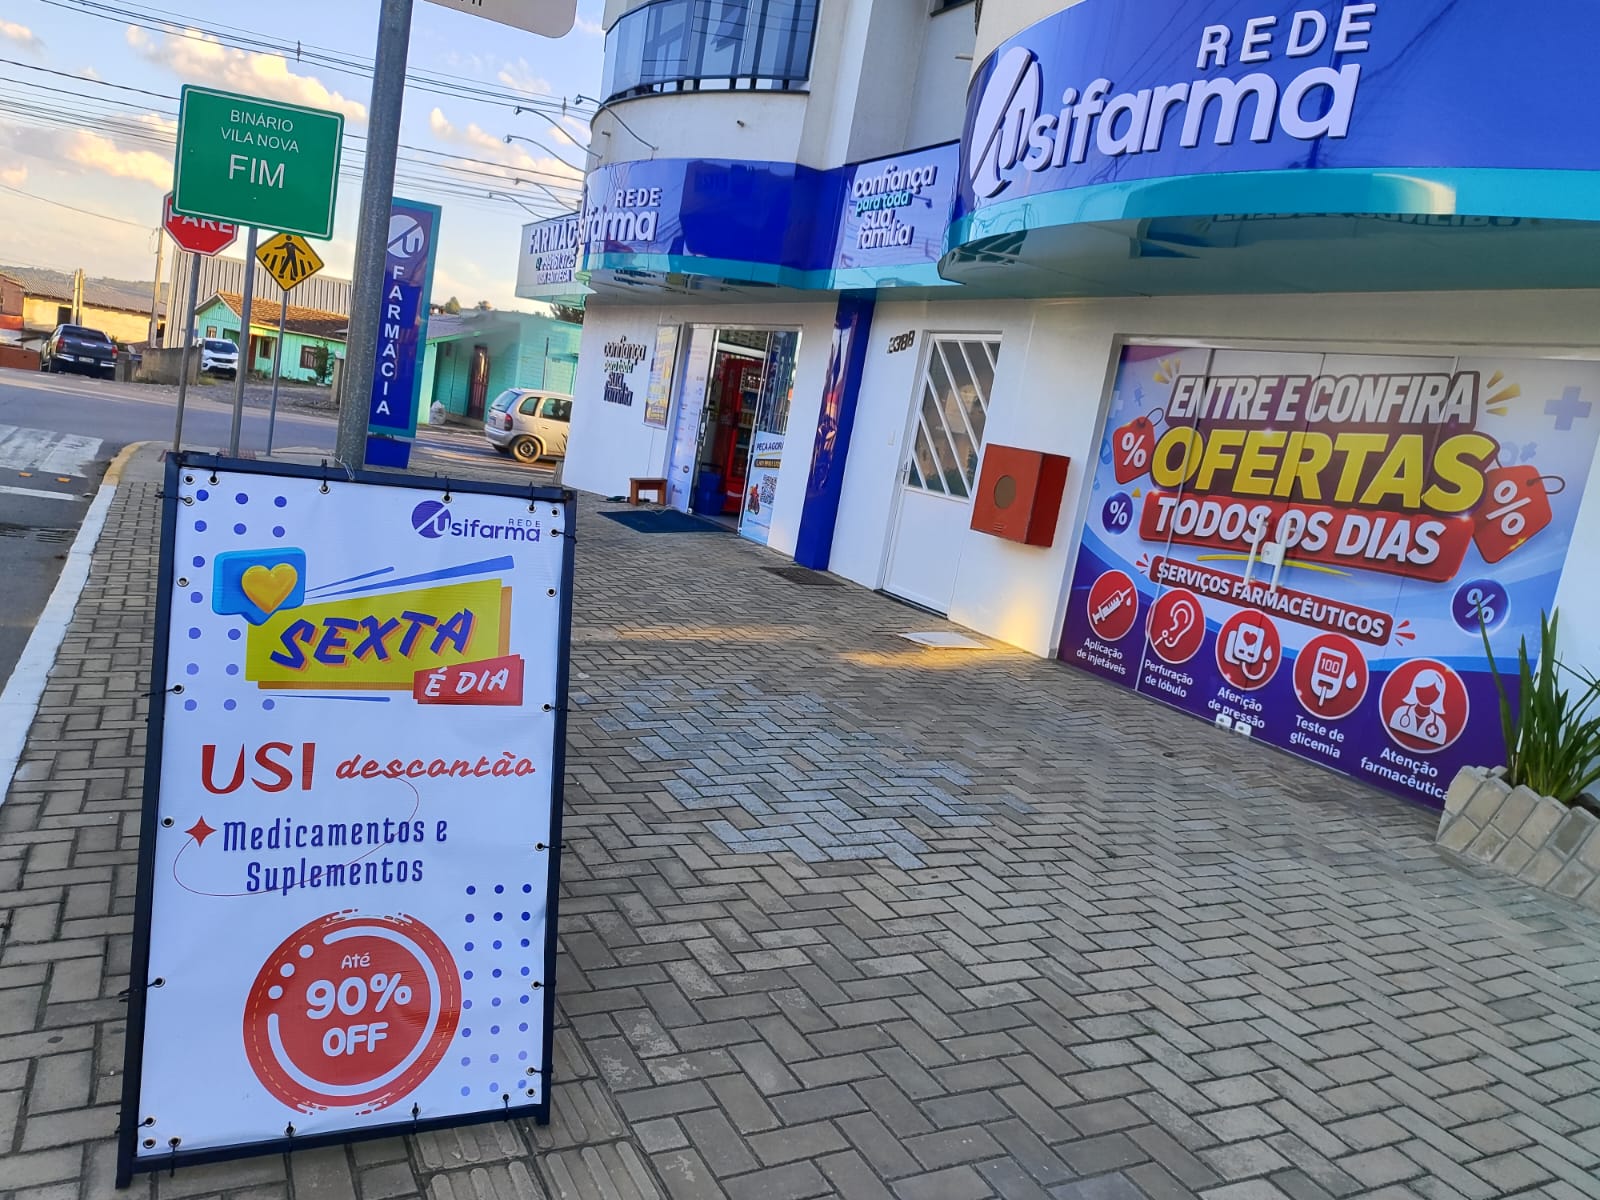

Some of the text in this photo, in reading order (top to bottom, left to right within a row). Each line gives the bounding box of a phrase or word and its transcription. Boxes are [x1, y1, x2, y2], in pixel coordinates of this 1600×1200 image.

[1196, 3, 1377, 69] REDE
[230, 109, 294, 133] BINÁRIO
[221, 127, 299, 153] VILA NOVA
[229, 154, 285, 189] FIM
[855, 164, 938, 198] confiança
[616, 187, 662, 208] REDE
[856, 191, 913, 217] para toda
[864, 209, 896, 231] sua
[376, 265, 405, 415] FARMÁCIA
[1169, 373, 1475, 424] ENTRE E CONFIRA
[1151, 425, 1497, 513] OFERTAS
[508, 518, 541, 528] REDE
[1156, 496, 1447, 565] TODOS OS DIAS
[1157, 562, 1386, 639] SERVIÇOS FARMACÊUTICOS
[269, 607, 478, 672] SEXTA
[1083, 637, 1123, 661] Aplicação
[1076, 649, 1127, 675] de injetáveis
[1144, 659, 1194, 686] Perfuração
[1320, 658, 1340, 675] 100
[424, 666, 510, 698] É DIA
[1145, 674, 1187, 699] de lóbulo
[1208, 699, 1265, 730] de pressão
[1217, 686, 1263, 712] Aferição
[1295, 714, 1345, 743] Teste de
[1289, 731, 1341, 759] glicemia
[201, 740, 317, 795] USI
[1380, 747, 1439, 779] Atenção
[222, 817, 448, 852] Medicamentos e
[246, 857, 424, 897] Suplementos
[341, 952, 371, 970] Até
[306, 972, 412, 1020] 90%
[322, 1022, 389, 1057] OFF
